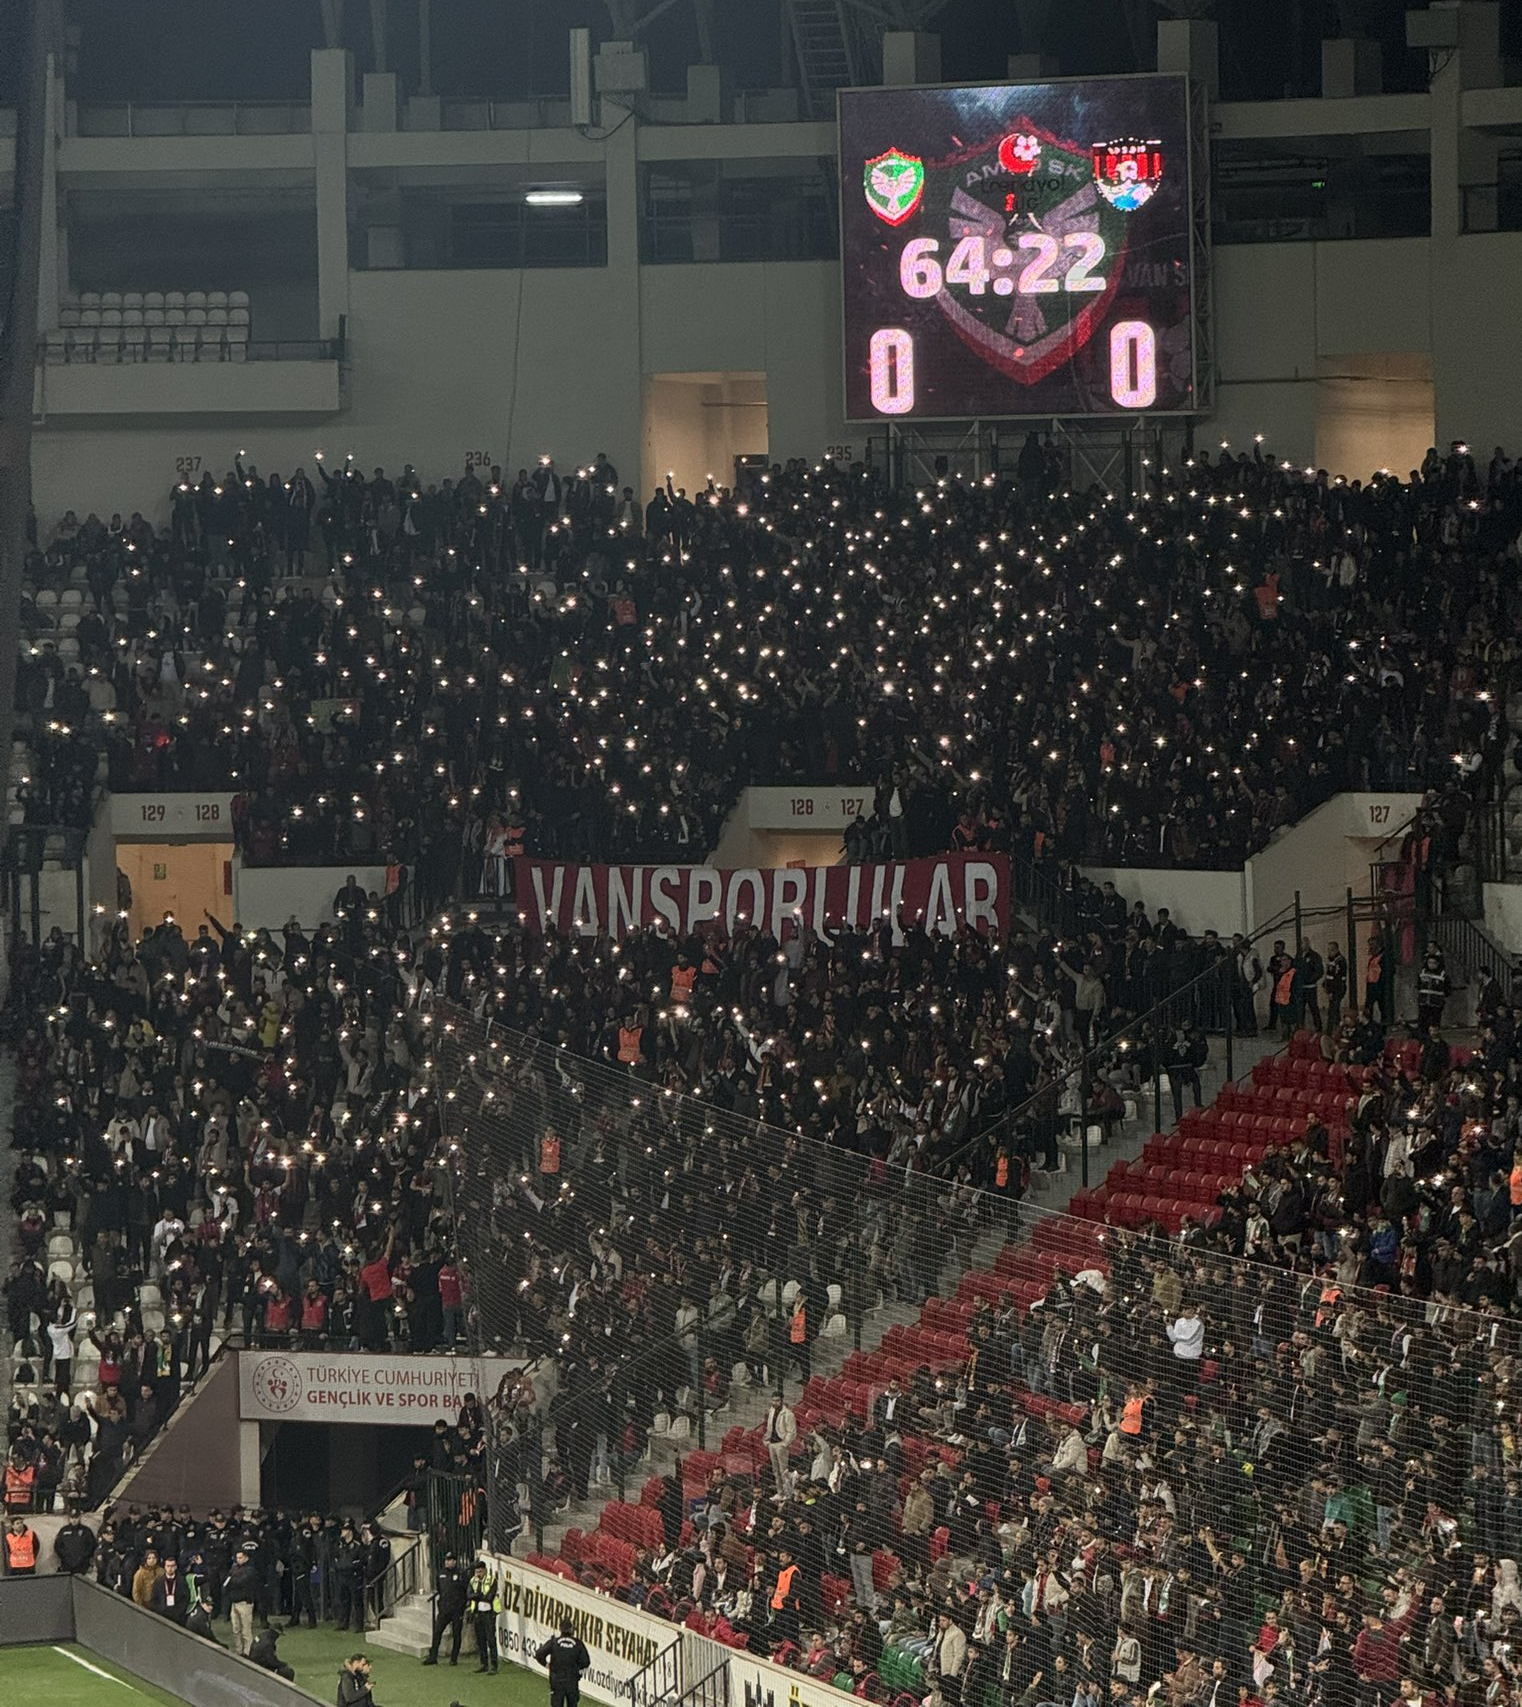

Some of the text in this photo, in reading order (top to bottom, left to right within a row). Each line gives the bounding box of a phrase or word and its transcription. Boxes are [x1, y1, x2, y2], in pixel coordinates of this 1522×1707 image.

[900, 232, 1106, 298] 64:22
[870, 329, 914, 414] 0
[1110, 321, 1156, 408] 0
[176, 457, 201, 473] 237
[465, 451, 491, 467] 236
[141, 804, 219, 821] 129 128
[790, 799, 864, 816] 128 127
[1369, 805, 1390, 823] 127
[306, 1364, 370, 1384] TÜRKİYE
[306, 1388, 371, 1409] GENÇLİK
[375, 1392, 394, 1407] VE
[398, 1393, 438, 1408] SPOR
[503, 1570, 521, 1614] ÖZ
[498, 1626, 519, 1653] 0850
